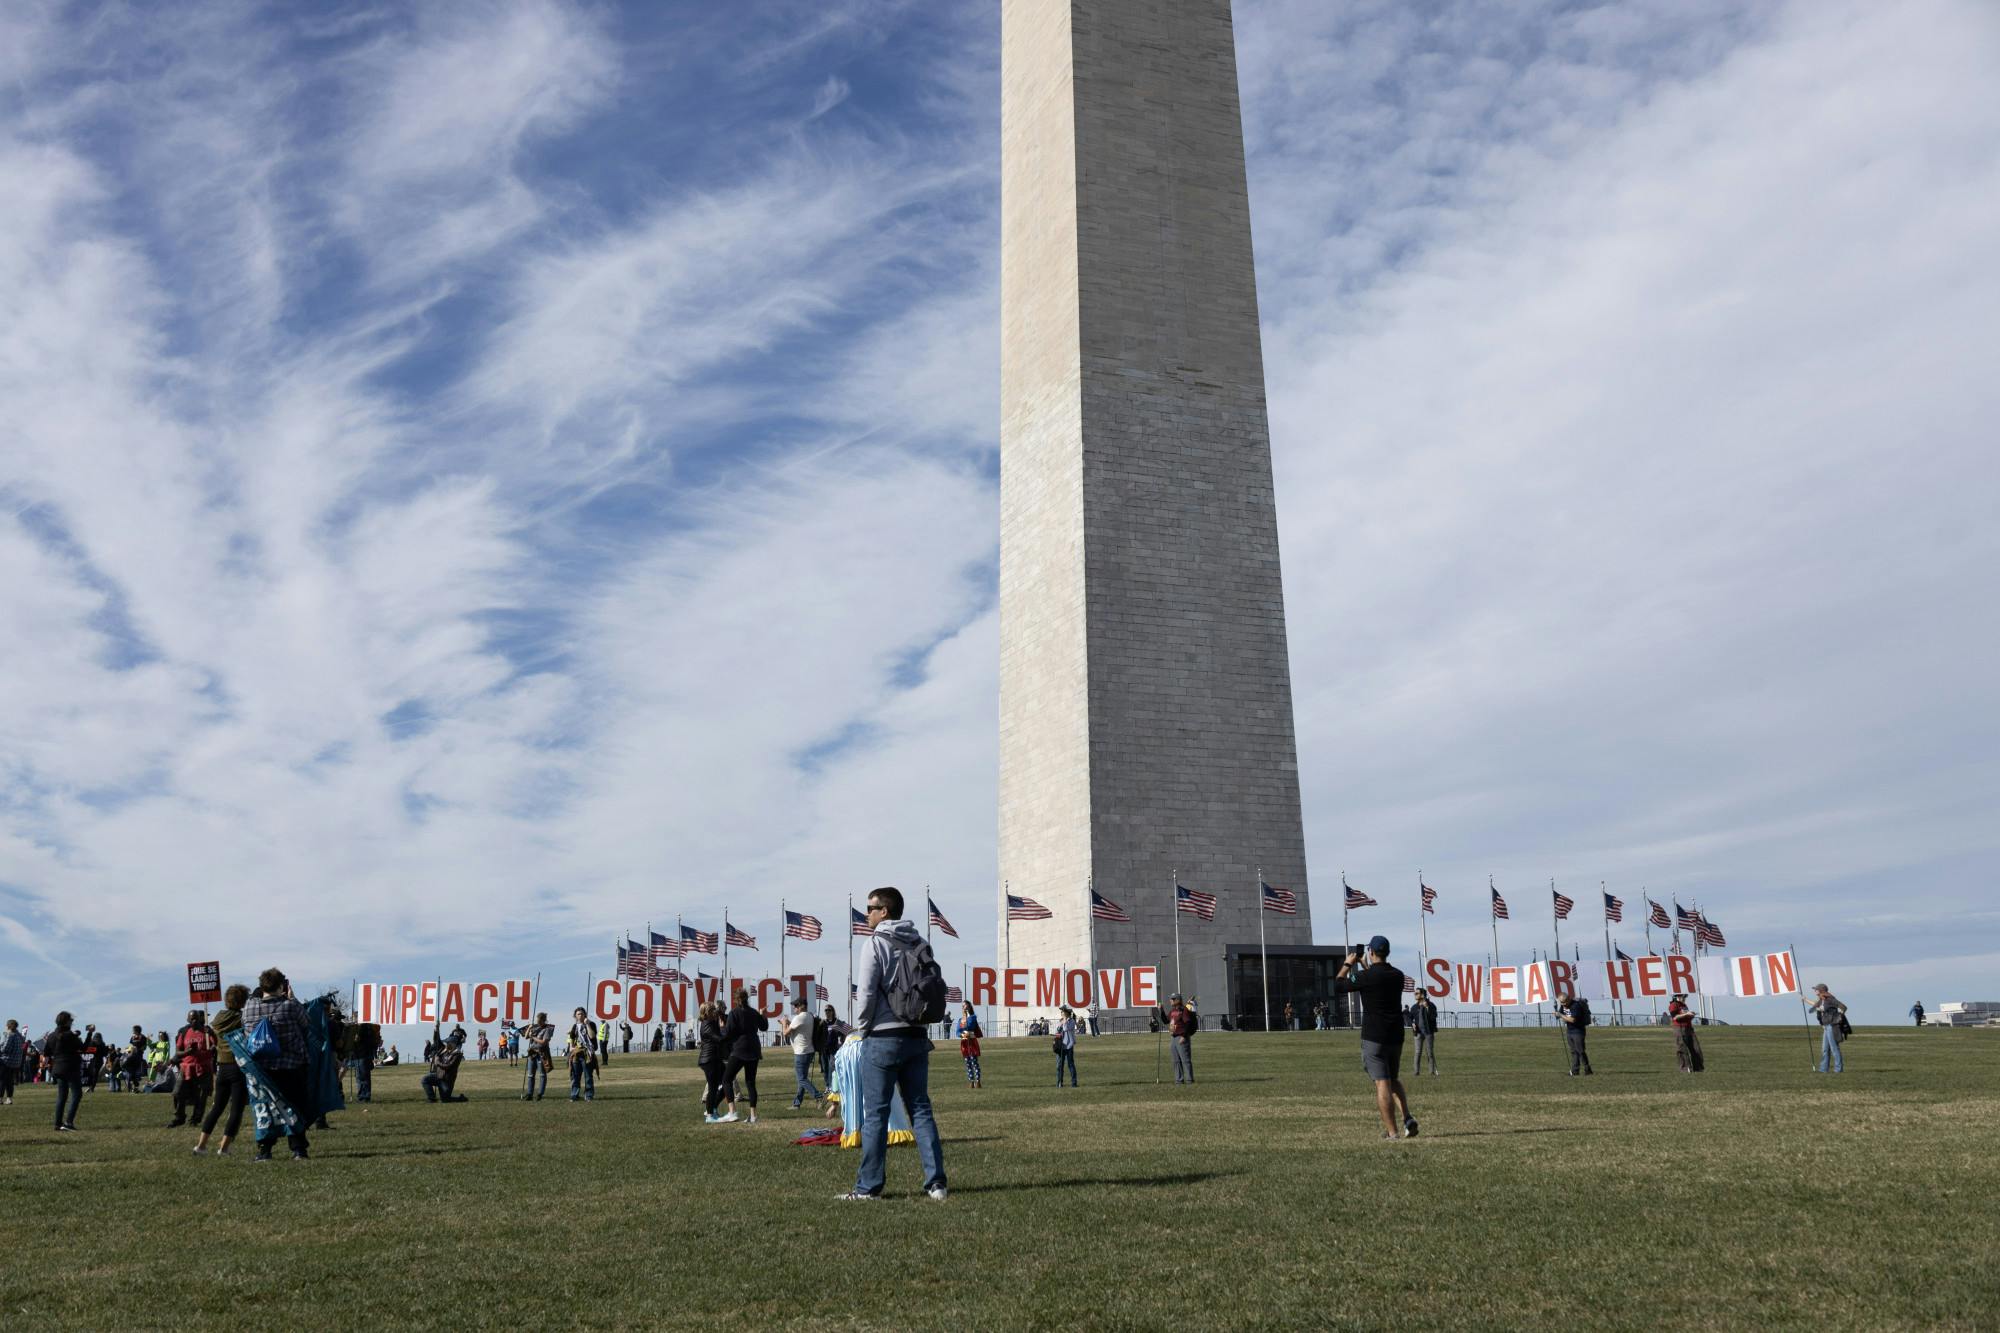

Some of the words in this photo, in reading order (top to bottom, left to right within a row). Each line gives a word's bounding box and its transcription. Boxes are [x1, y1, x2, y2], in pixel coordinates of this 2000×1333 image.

[191, 973, 218, 983] LARGUE
[192, 982, 217, 991] TRUMP
[207, 965, 217, 973] SE
[972, 967, 1156, 1009] REMOVE
[1606, 955, 1696, 1000] HER
[1738, 951, 1796, 996] IN
[363, 980, 531, 1024] IMPEACH
[595, 975, 815, 1024] CONVICT
